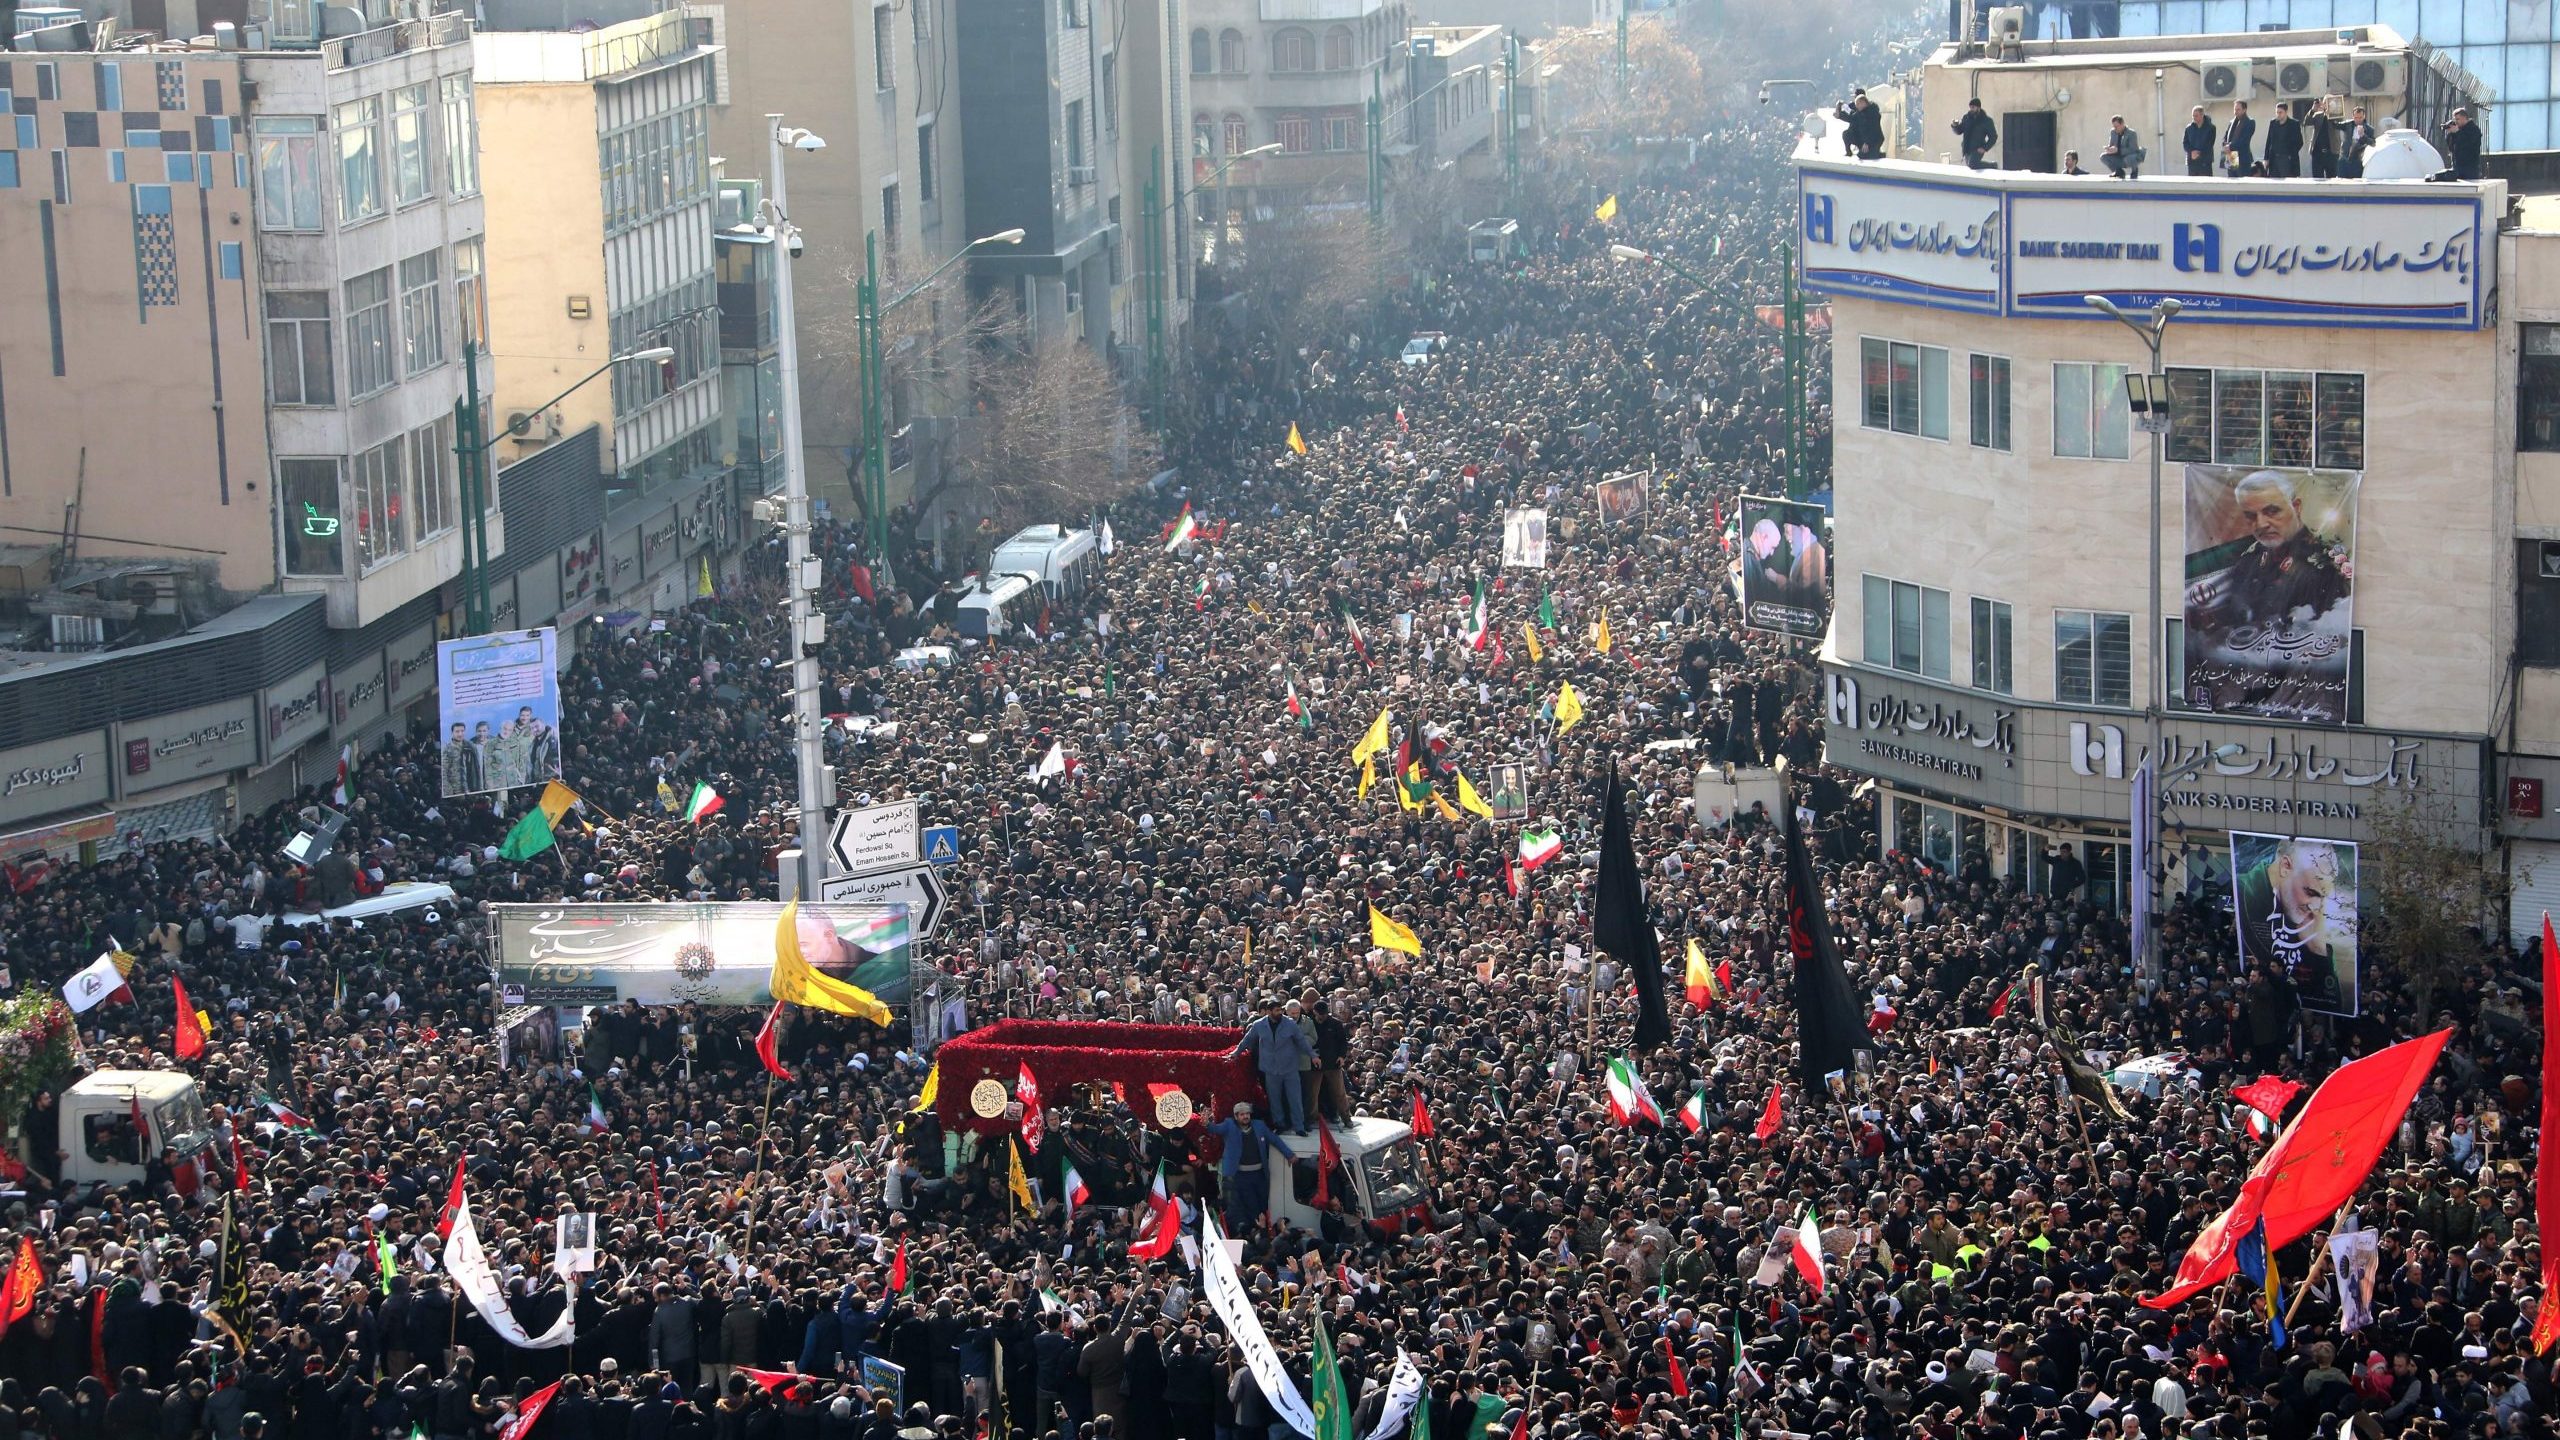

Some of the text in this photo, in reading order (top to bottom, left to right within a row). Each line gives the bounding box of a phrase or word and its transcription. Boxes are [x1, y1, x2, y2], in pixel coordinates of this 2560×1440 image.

[1848, 210, 2000, 273] بانک صادرات ایران
[2019, 240, 2160, 260] BANK SADERAT IRAN
[2233, 227, 2471, 285] بانک صادرات ایران
[2226, 622, 2314, 655] سلیمانی
[2299, 634, 2340, 665] شهید
[2314, 636, 2330, 650] حاج
[2236, 667, 2253, 689] سلیمانی
[2251, 672, 2268, 690] قاسم
[2267, 677, 2281, 689] حاج
[1866, 694, 2017, 768] بانک صادرات ایران
[4, 752, 86, 797] آبمیوه دکتر
[2342, 737, 2423, 803] بانک
[872, 808, 903, 824] فردوسی
[2162, 790, 2201, 808] ANK
[2305, 800, 2359, 820] IRAN
[865, 828, 888, 842] حسین
[888, 825, 904, 838] امام
[855, 857, 876, 867] Emam
[875, 852, 901, 864] Hossein
[832, 878, 902, 901] جمهوری اسلامی
[614, 913, 660, 927] سردار
